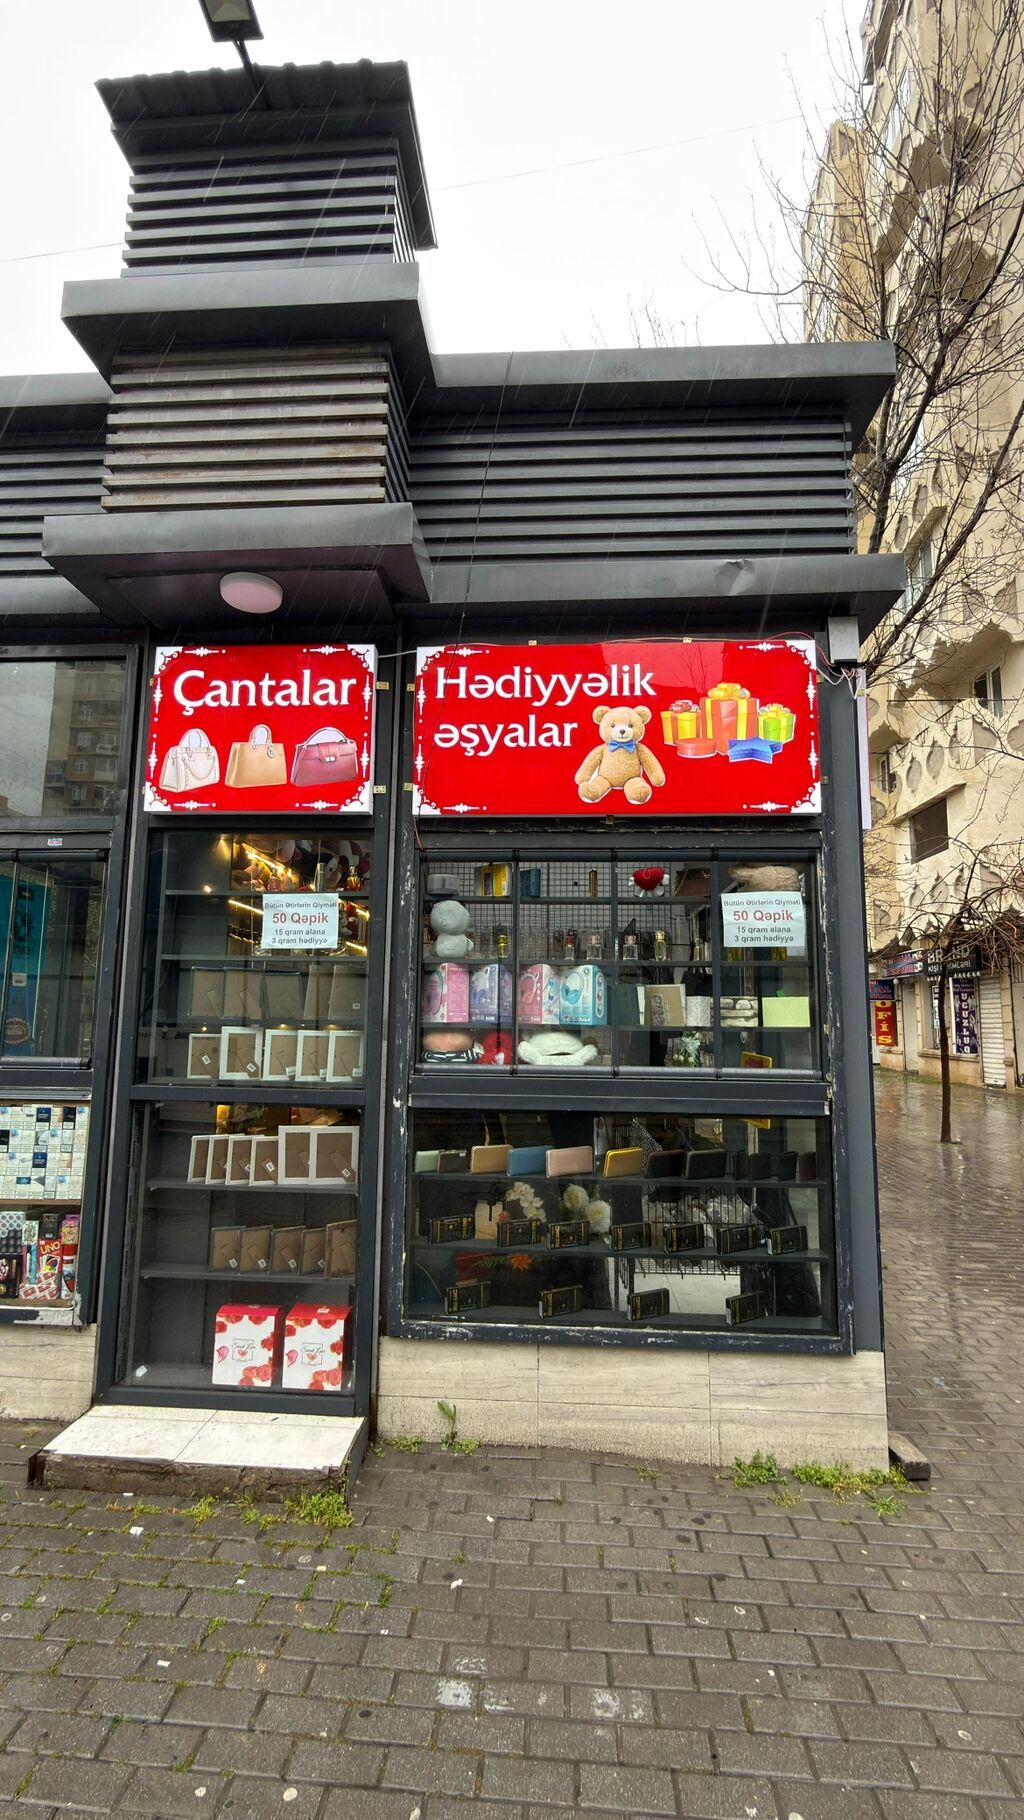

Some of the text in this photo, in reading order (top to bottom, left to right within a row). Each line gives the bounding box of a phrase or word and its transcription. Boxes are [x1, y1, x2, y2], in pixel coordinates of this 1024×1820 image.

[434, 663, 657, 707] Hədiyyəlik
[173, 669, 357, 716] Çantalar
[433, 715, 578, 757] əşyalar
[774, 898, 801, 906] Qiyməti
[272, 912, 329, 926] 50 Qəpik
[733, 910, 793, 923] 50 Qəpik
[298, 937, 328, 945] hədiyyə
[763, 935, 794, 943] hədiyyə
[874, 1000, 893, 1044] OFİS
[39, 1241, 61, 1254] UNO
